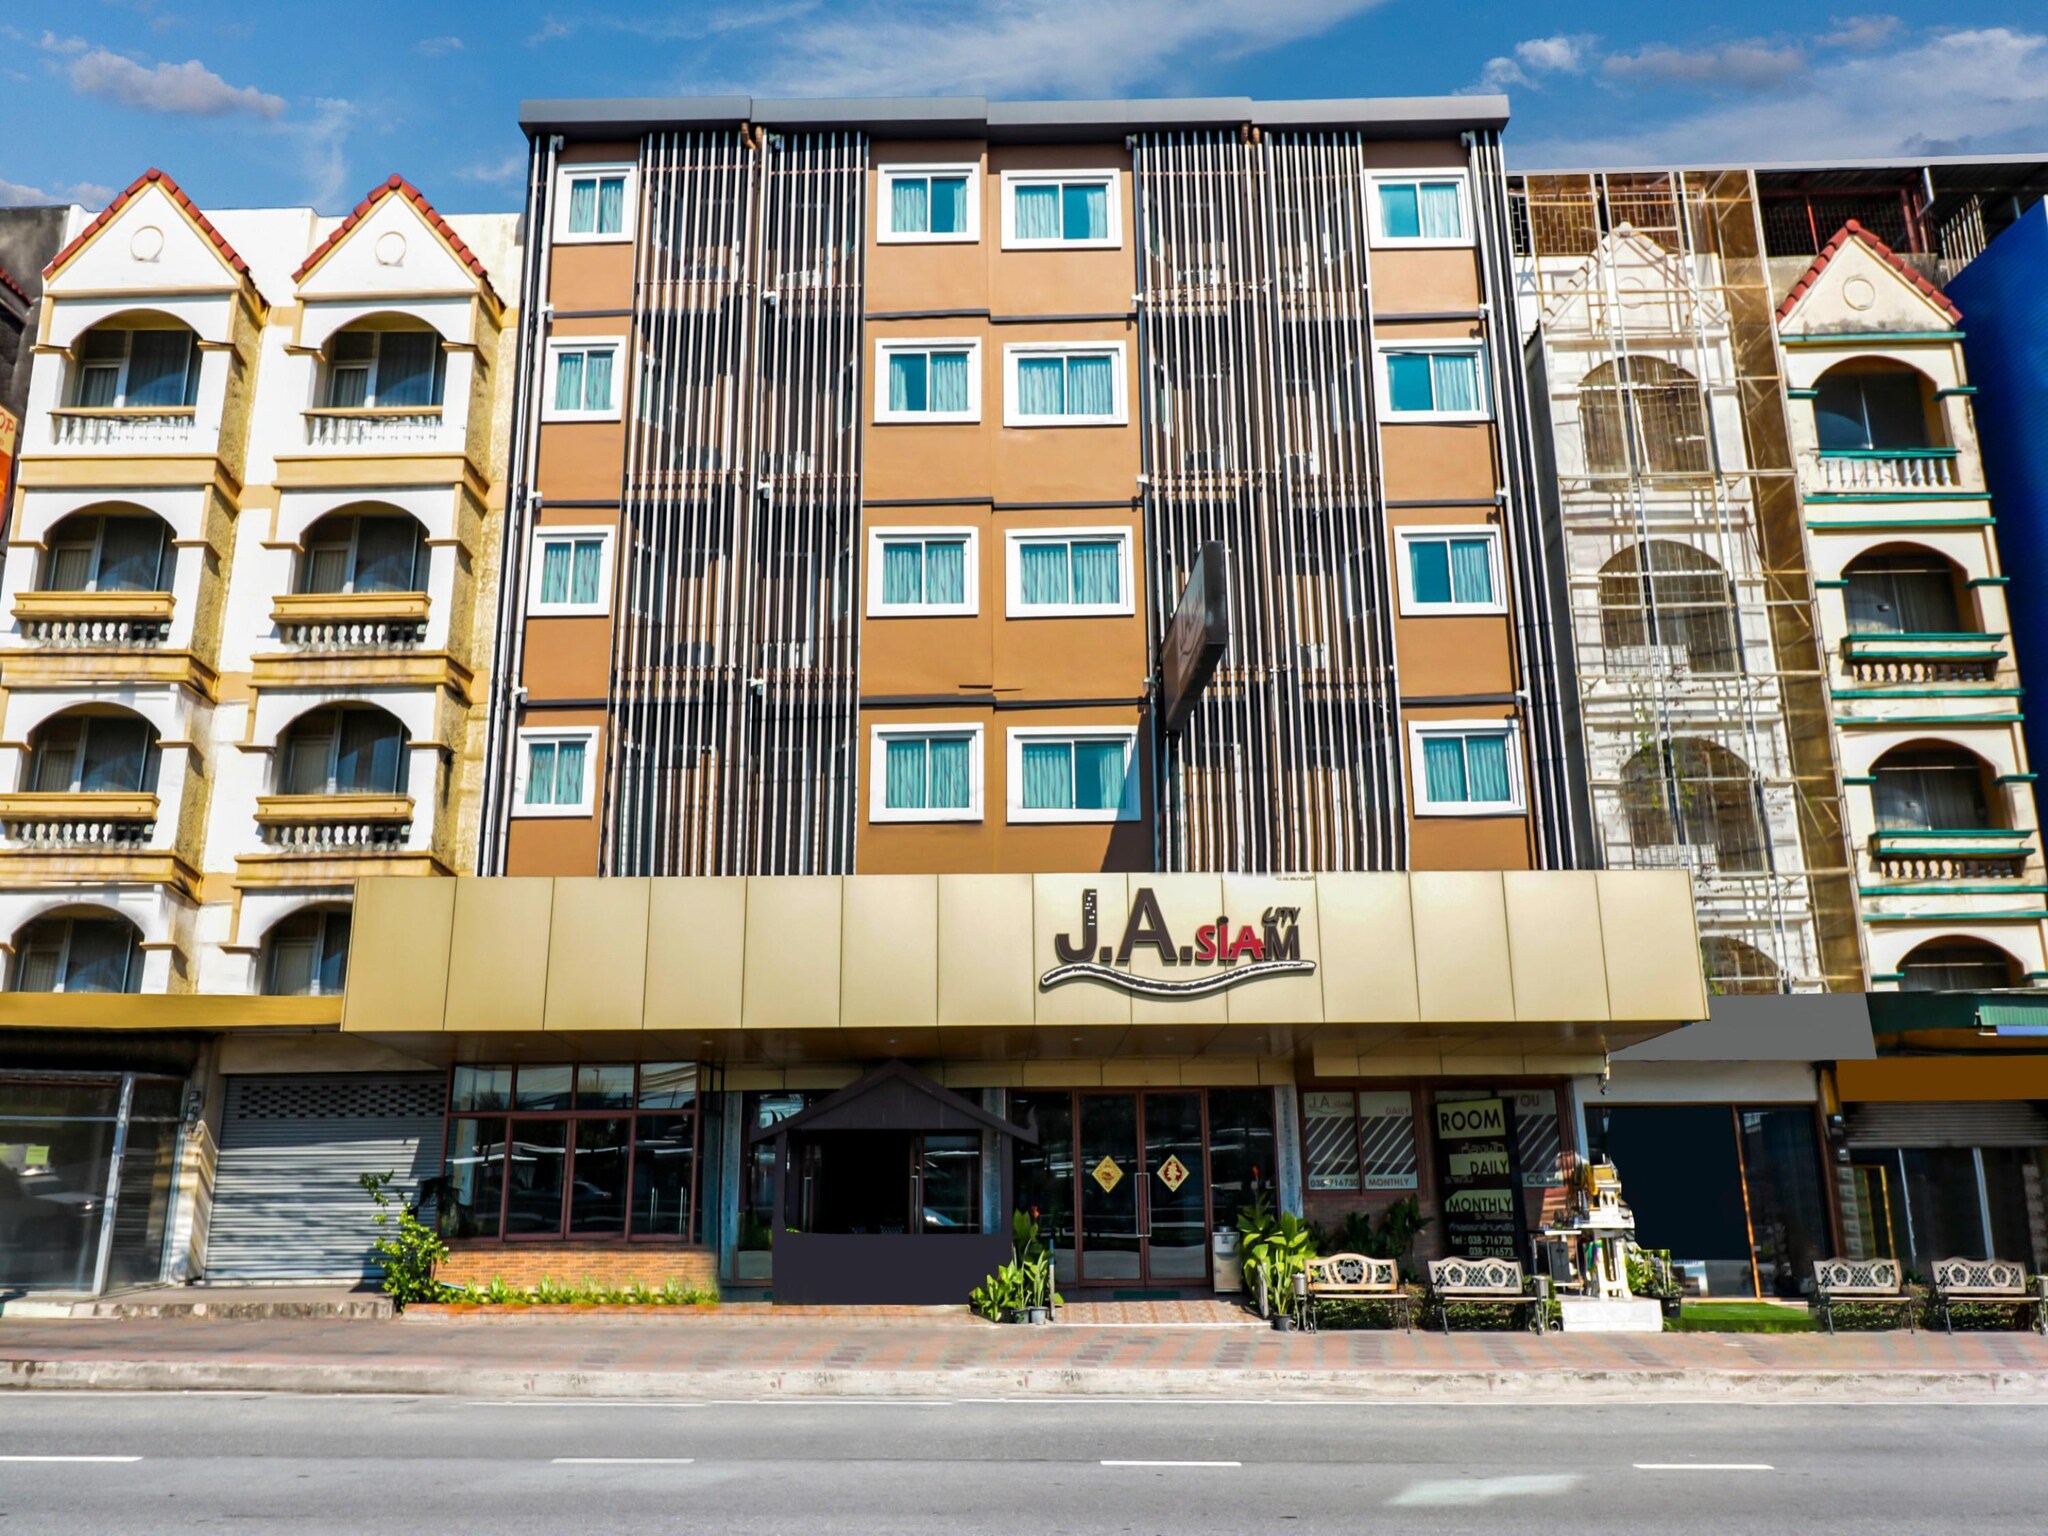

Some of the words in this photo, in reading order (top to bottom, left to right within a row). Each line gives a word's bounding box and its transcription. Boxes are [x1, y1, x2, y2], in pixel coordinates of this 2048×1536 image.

[1385, 1106, 1409, 1115] DAILY
[1440, 1108, 1501, 1131] ROOM
[1470, 1159, 1508, 1175] DAILY
[1368, 1178, 1409, 1187] MONTHLY
[1448, 1196, 1512, 1214] MONTHLY
[1468, 1235, 1513, 1245] 038-716730
[1468, 1246, 1514, 1256] 038-716573
